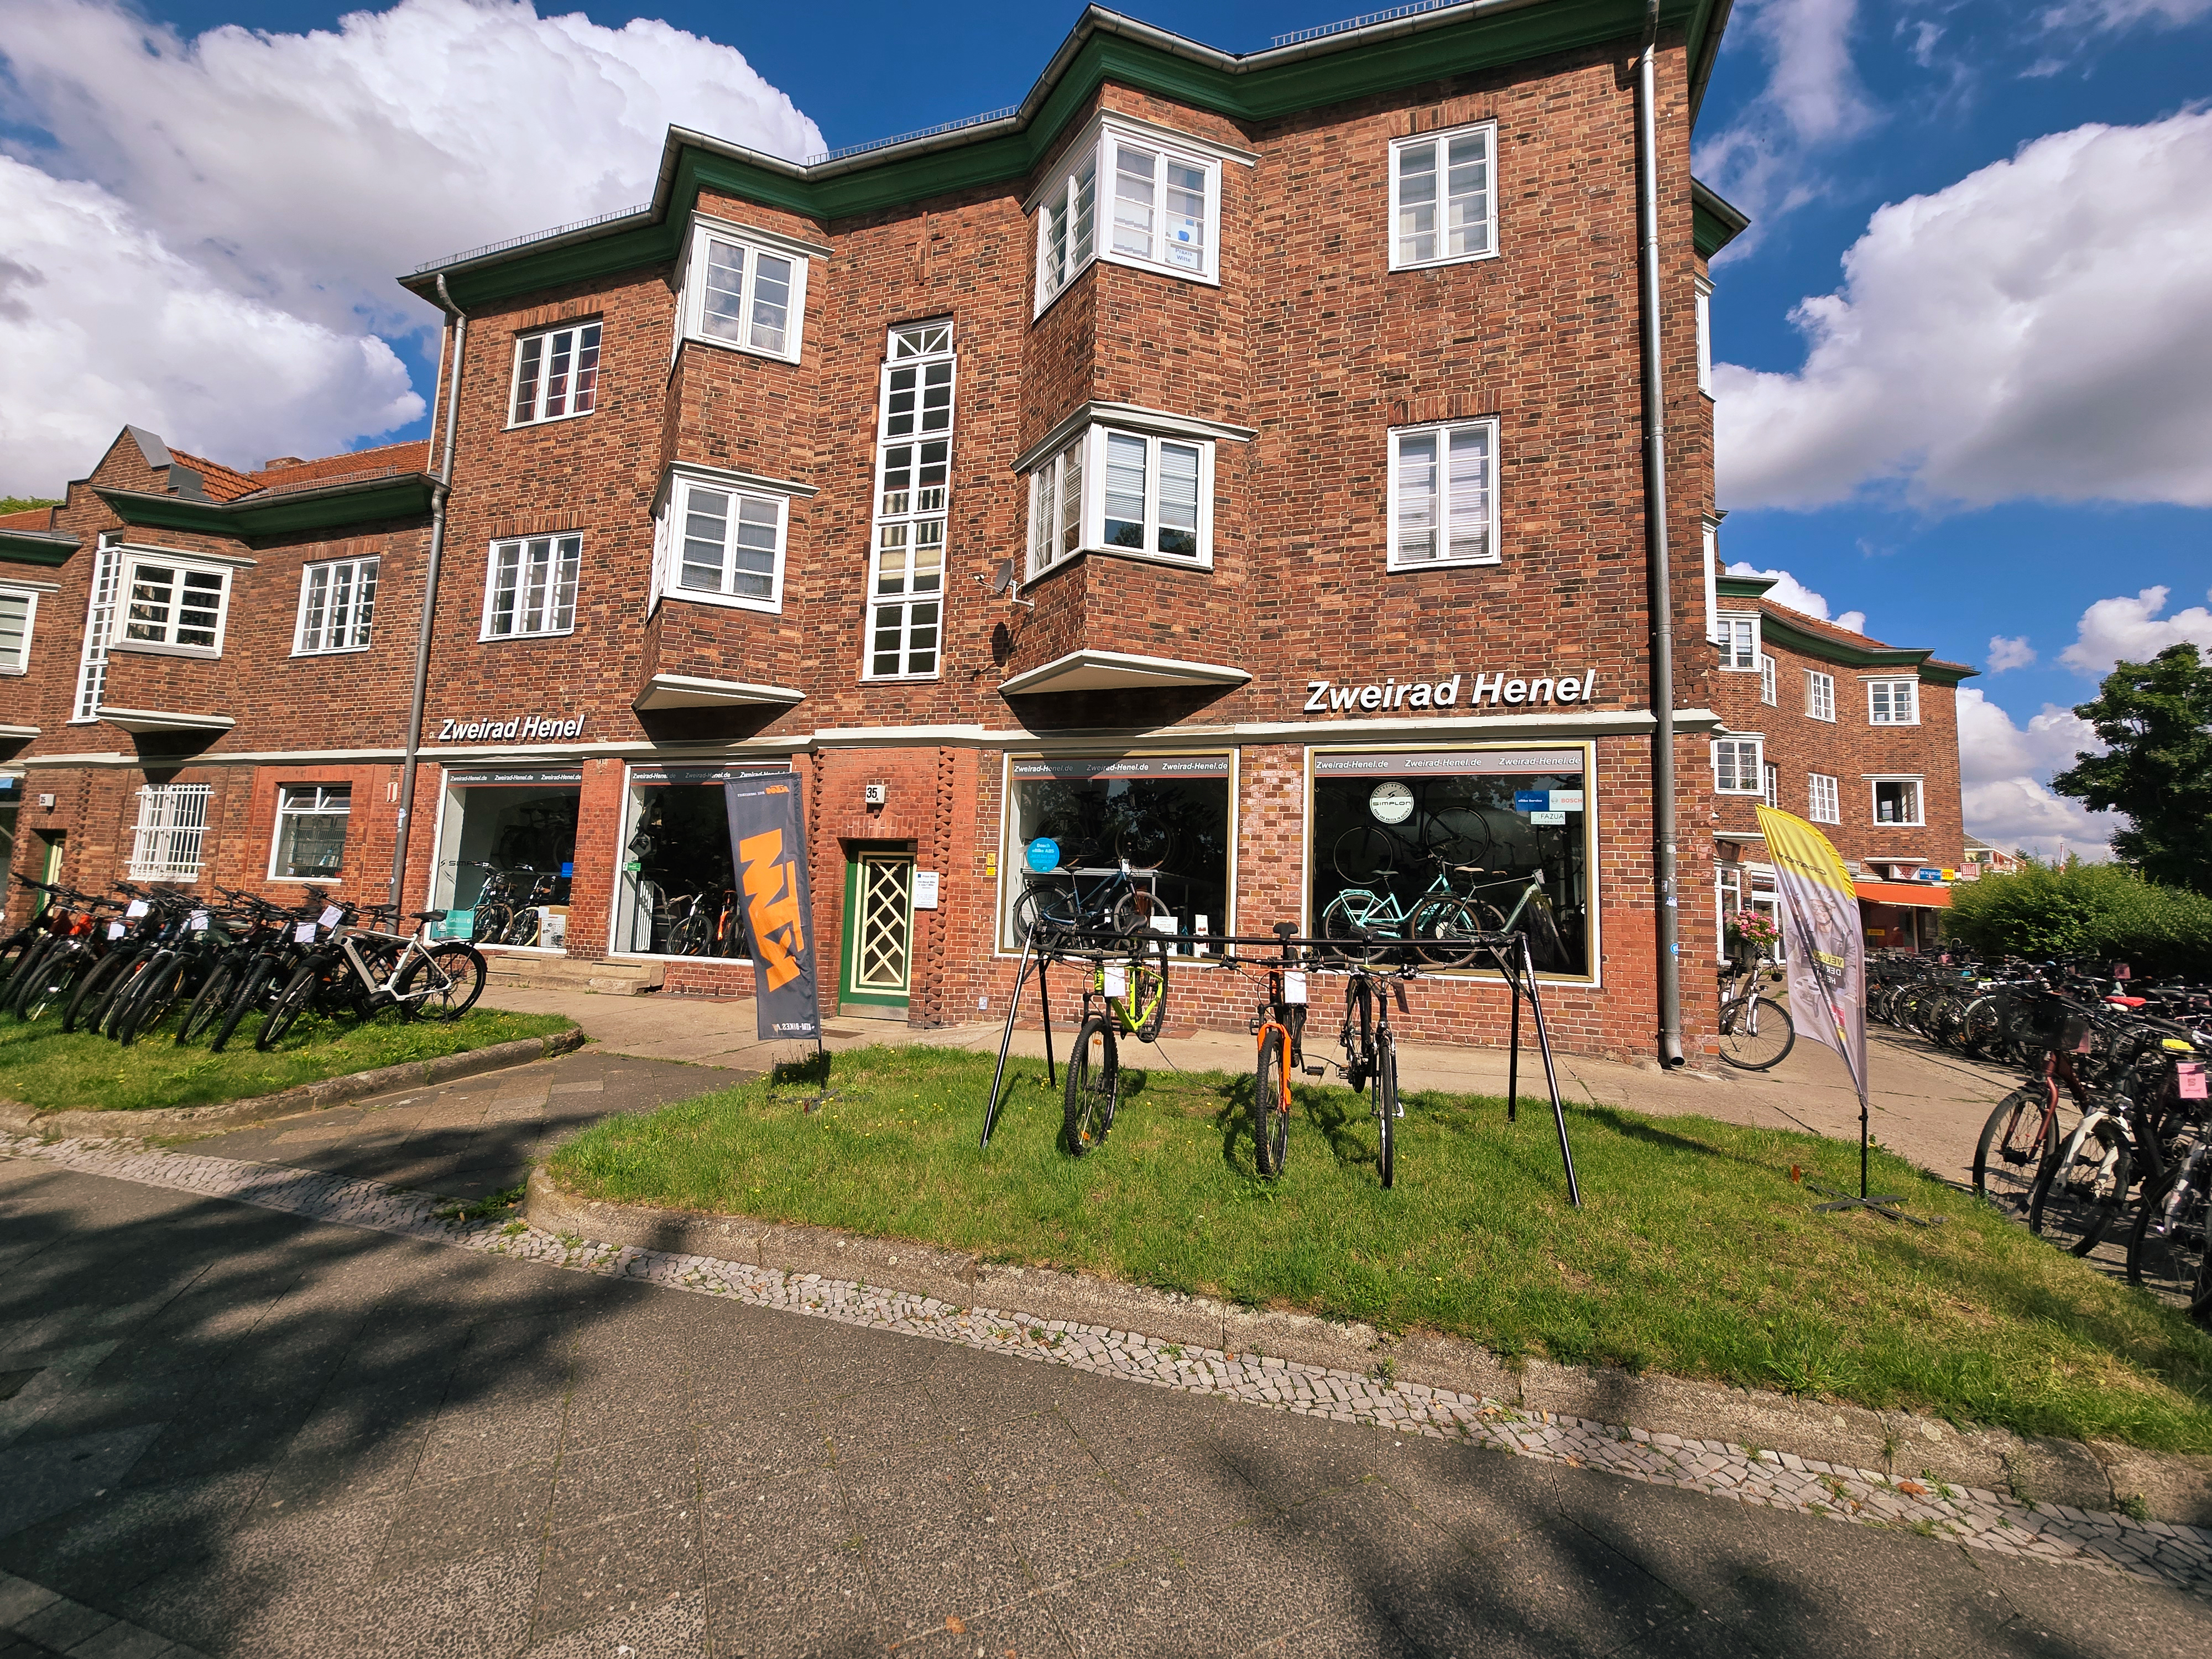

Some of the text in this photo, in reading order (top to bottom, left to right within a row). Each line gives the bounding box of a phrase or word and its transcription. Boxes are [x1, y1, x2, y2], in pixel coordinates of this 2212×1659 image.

[1175, 248, 1193, 256] Praxis
[1303, 669, 1596, 711] Zweirad Henel
[438, 714, 585, 740] Zweirad Henel
[1162, 762, 1228, 770] Zweirad-Henel.de
[1316, 760, 1389, 769] Zweirad-Henel.de
[1405, 758, 1482, 767] Zweirad-Henel.de
[1498, 757, 1581, 766] Zweirad-Henel.de
[1086, 763, 1149, 771] Zweirad-Henel.de
[1962, 865, 1976, 874] Bild
